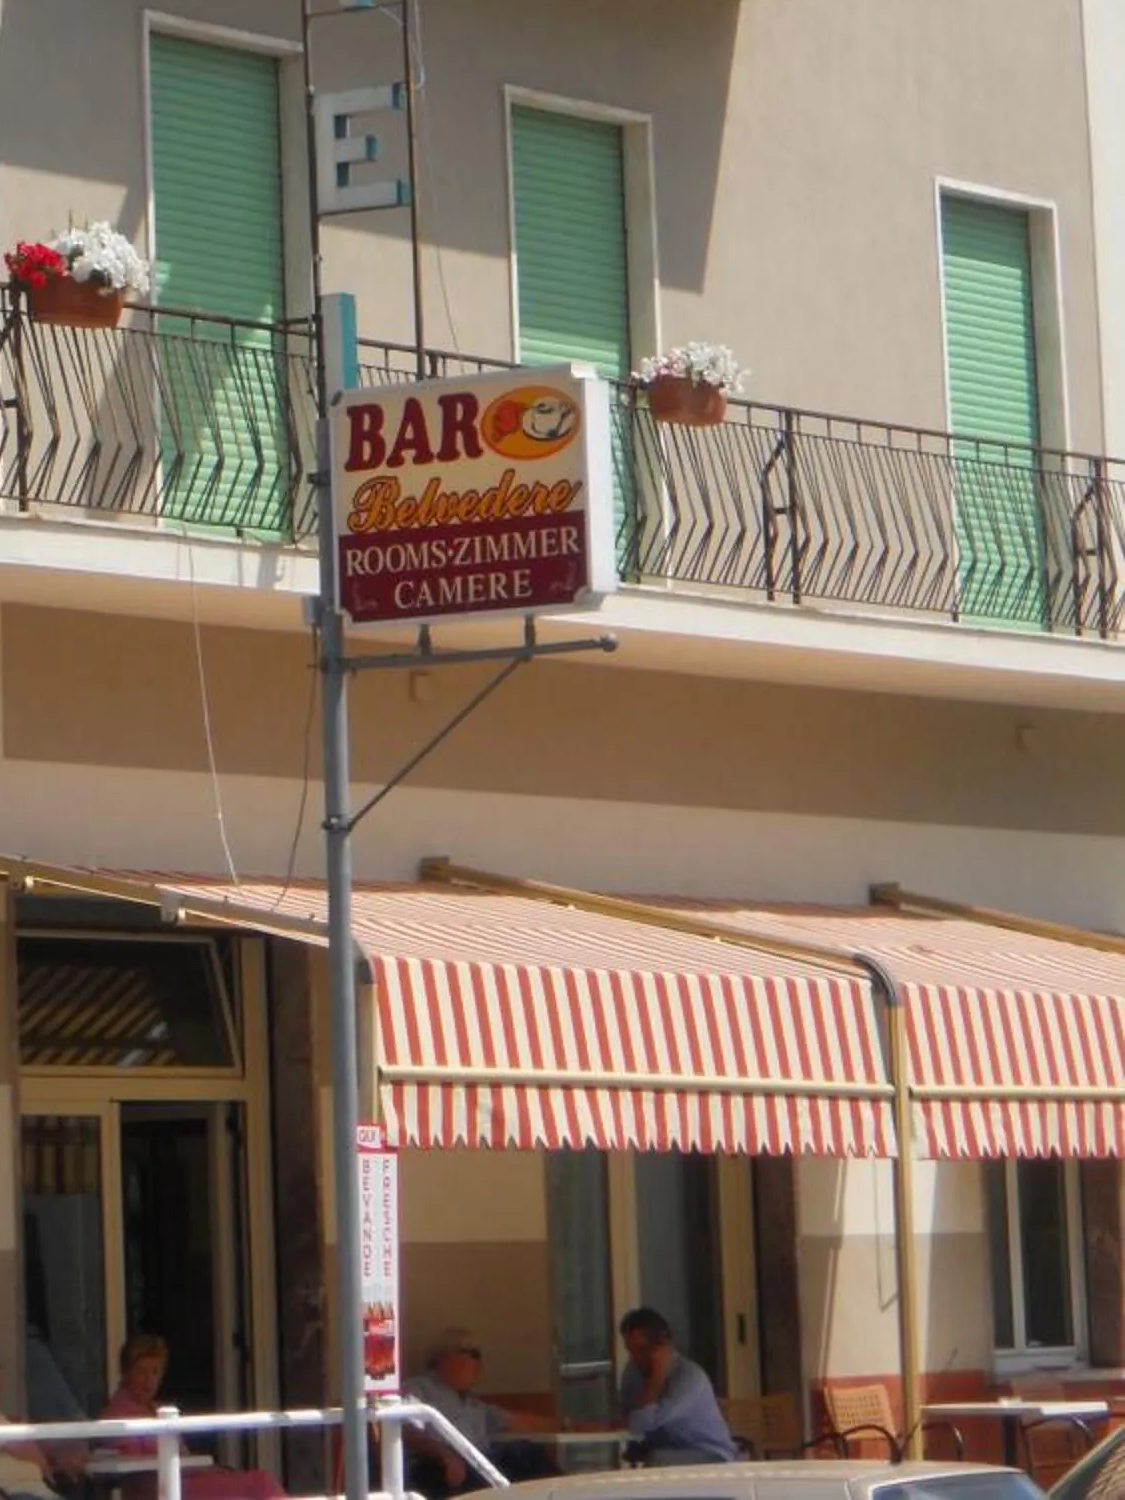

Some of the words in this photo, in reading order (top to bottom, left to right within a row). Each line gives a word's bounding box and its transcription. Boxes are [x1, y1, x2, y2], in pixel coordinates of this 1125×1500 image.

[344, 391, 484, 473] BAR
[347, 468, 583, 534] Belvedere
[394, 568, 533, 610] CAMERE
